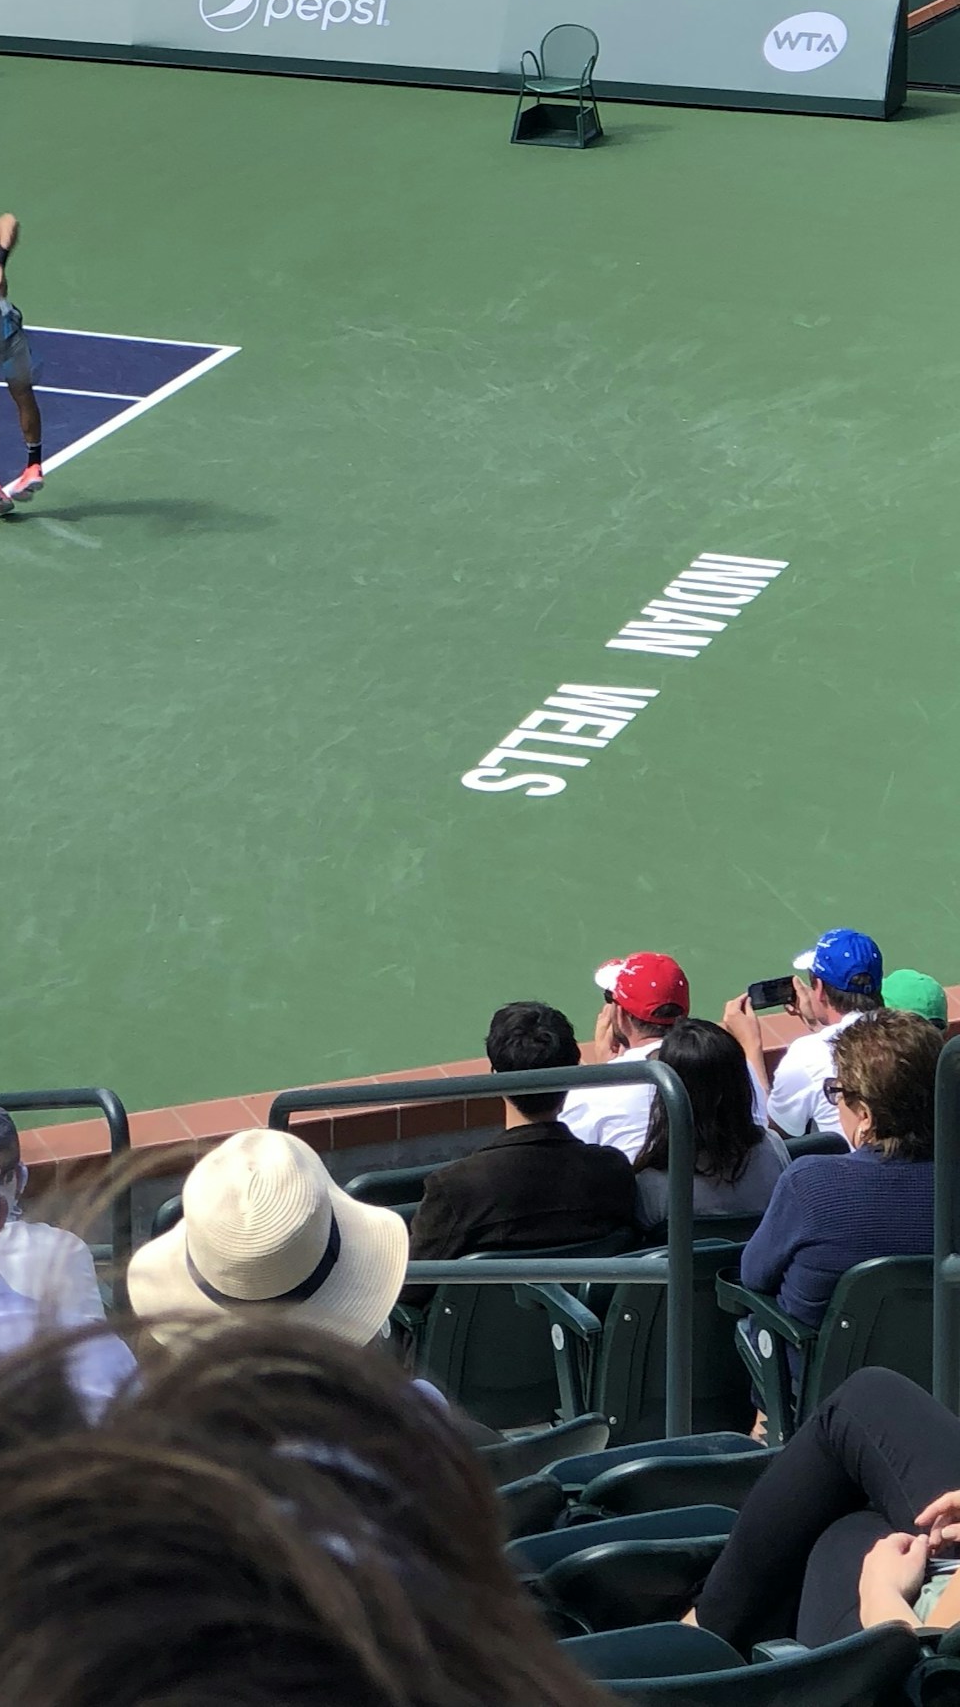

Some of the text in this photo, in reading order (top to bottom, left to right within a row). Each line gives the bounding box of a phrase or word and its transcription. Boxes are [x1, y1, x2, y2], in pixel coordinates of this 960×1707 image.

[773, 30, 838, 53] WTA
[461, 552, 790, 797] INDIAN WELLS
